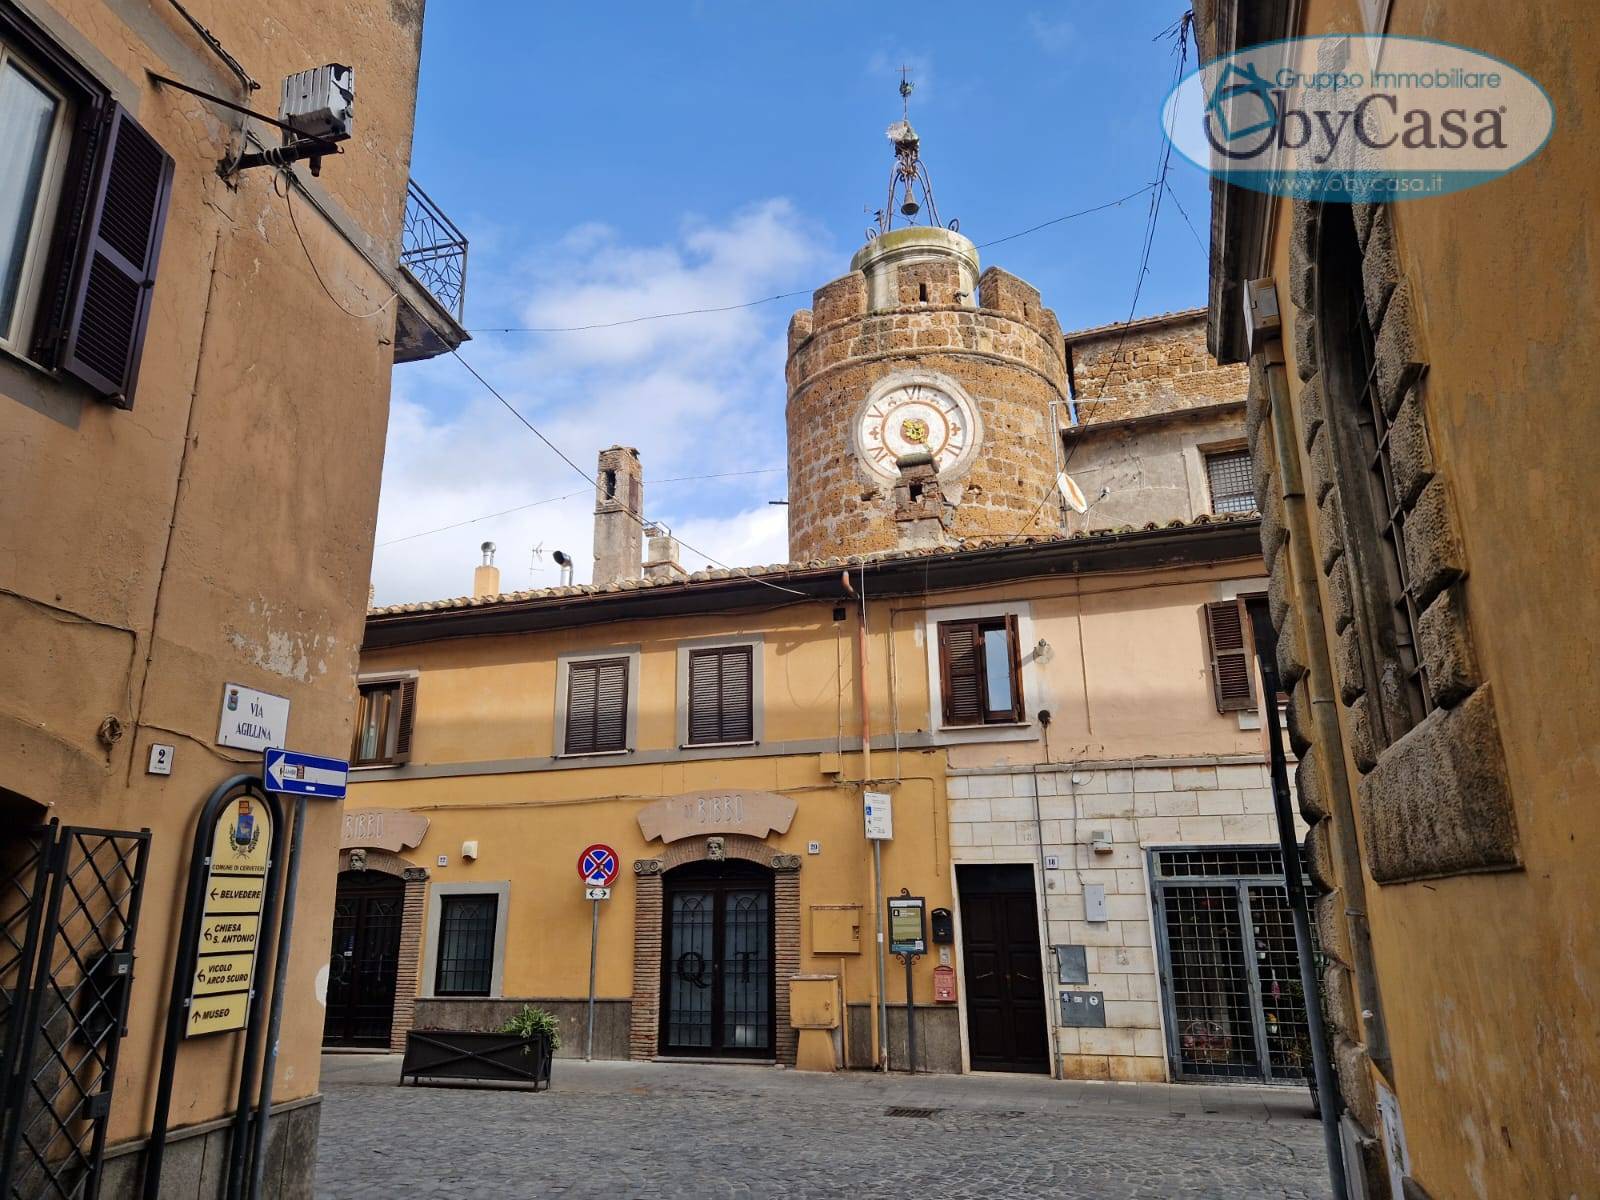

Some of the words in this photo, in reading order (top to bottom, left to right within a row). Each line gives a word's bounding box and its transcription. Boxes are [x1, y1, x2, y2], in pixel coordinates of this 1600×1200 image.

[250, 702, 264, 718] VIA
[236, 722, 271, 741] AGILLINA
[158, 748, 166, 764] 2
[220, 890, 262, 899] BELVEDERE
[214, 924, 241, 933] CHIESA
[213, 935, 220, 944] S.
[221, 933, 255, 944] ANTONIO
[208, 964, 232, 973] VICOLO
[207, 975, 226, 985] ARCO
[227, 973, 249, 983] SCURO
[202, 1008, 230, 1020] MUSEO
